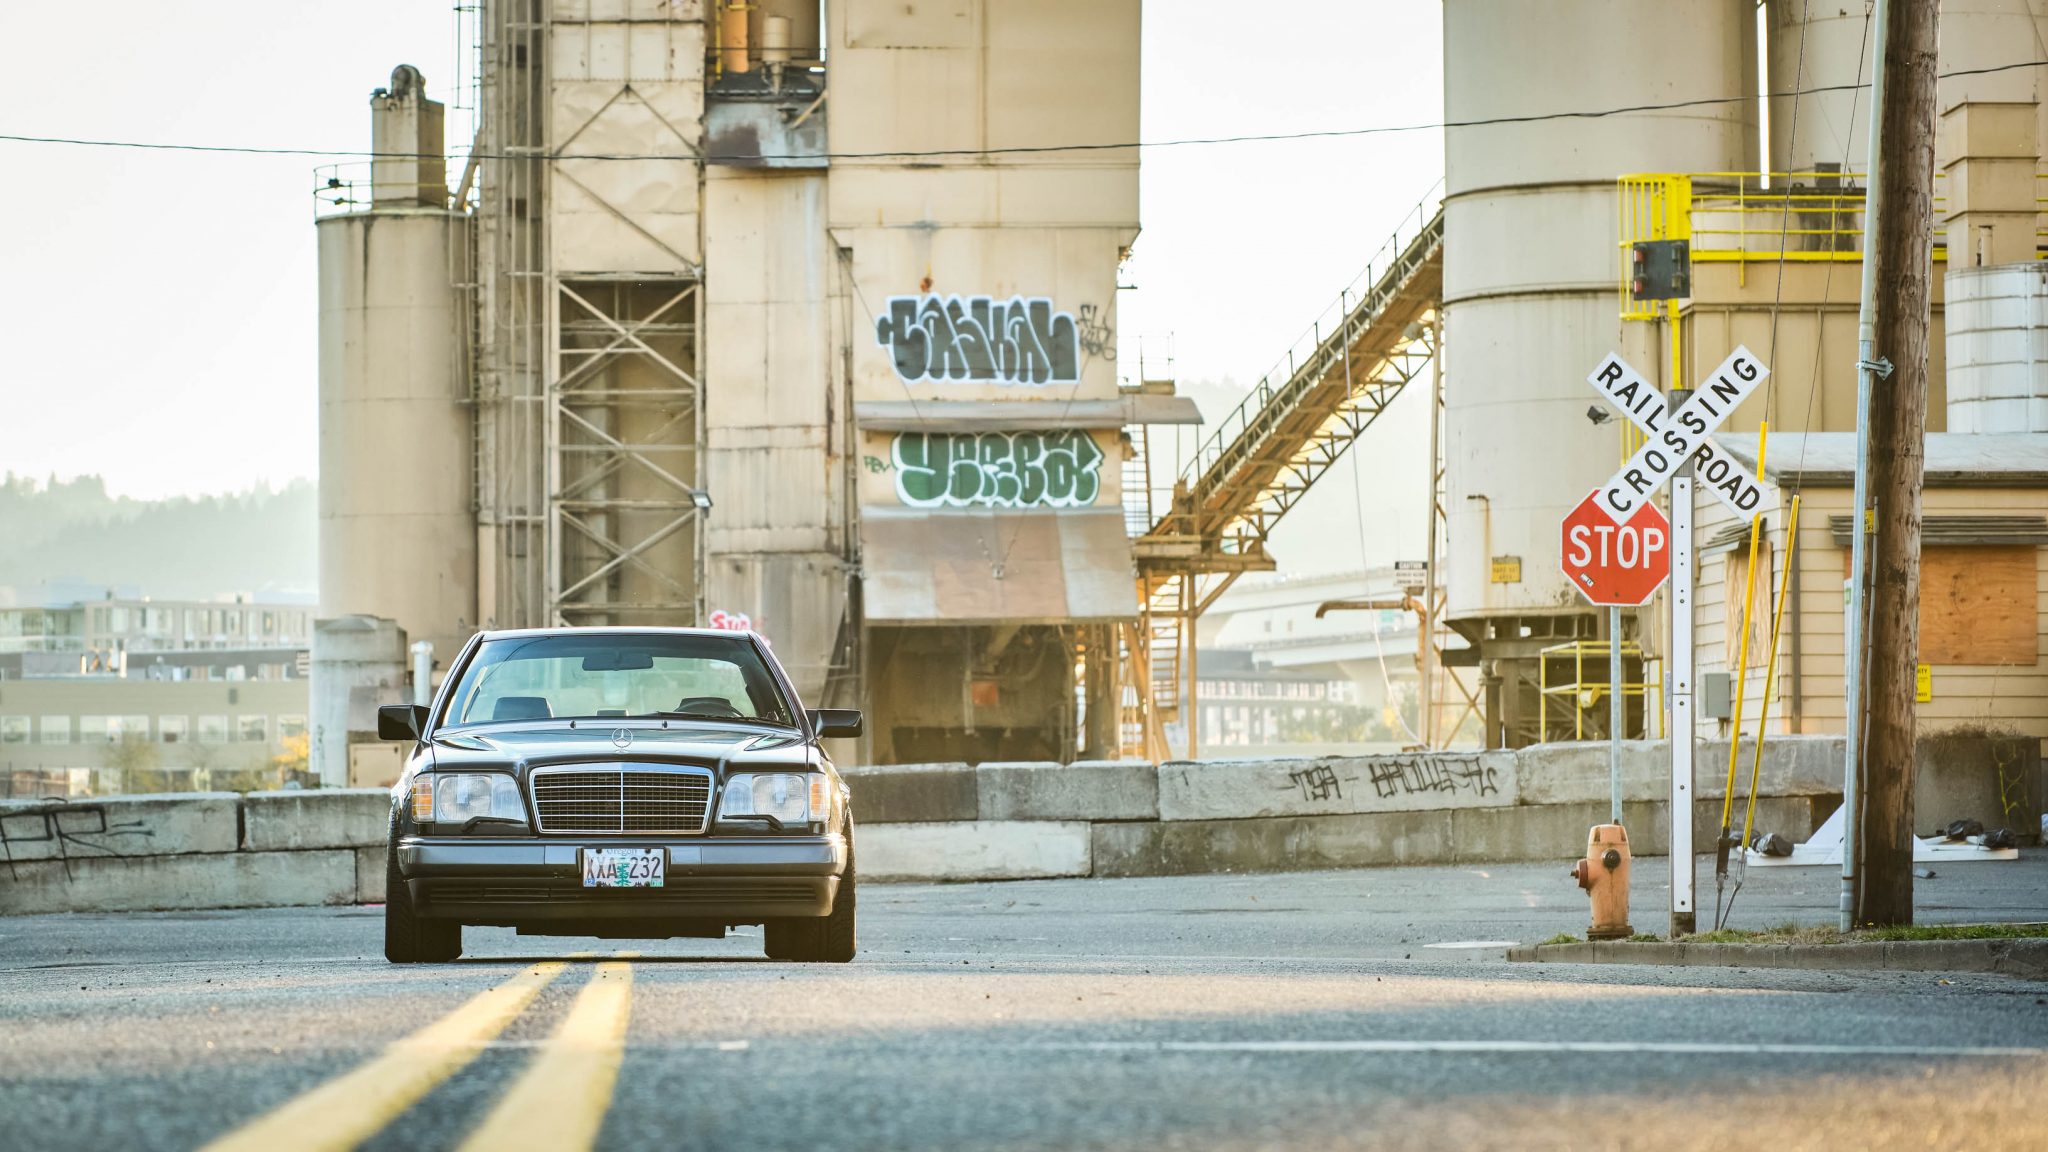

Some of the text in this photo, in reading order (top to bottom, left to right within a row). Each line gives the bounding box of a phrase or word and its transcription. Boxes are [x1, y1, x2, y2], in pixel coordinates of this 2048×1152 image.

[1597, 361, 1760, 510] RAIL ROAD
[1608, 358, 1757, 512] CROSSING
[1568, 524, 1665, 569] STOP
[629, 856, 662, 879] 232
